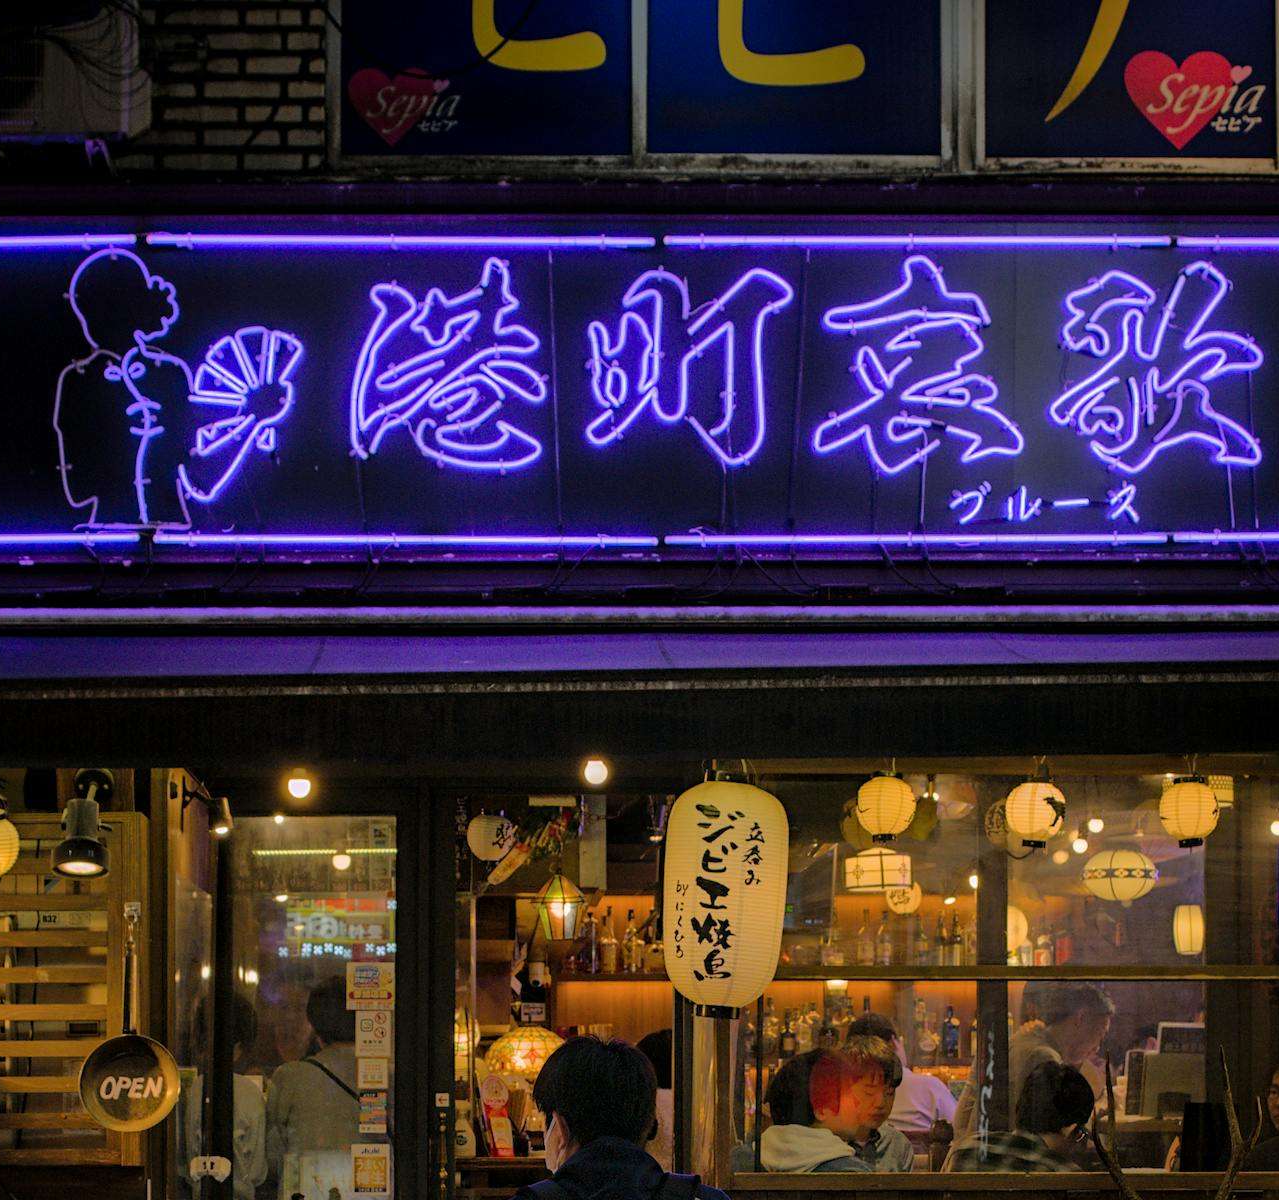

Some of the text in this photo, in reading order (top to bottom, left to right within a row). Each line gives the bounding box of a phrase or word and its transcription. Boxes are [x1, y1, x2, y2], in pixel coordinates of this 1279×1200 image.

[365, 79, 462, 134] Sepia
[1146, 65, 1267, 136] Sepia
[948, 483, 1140, 524] ブルース
[741, 822, 765, 886] 立呑み
[690, 804, 746, 982] ジビエ焼鳥
[99, 1076, 164, 1101] OPEN
